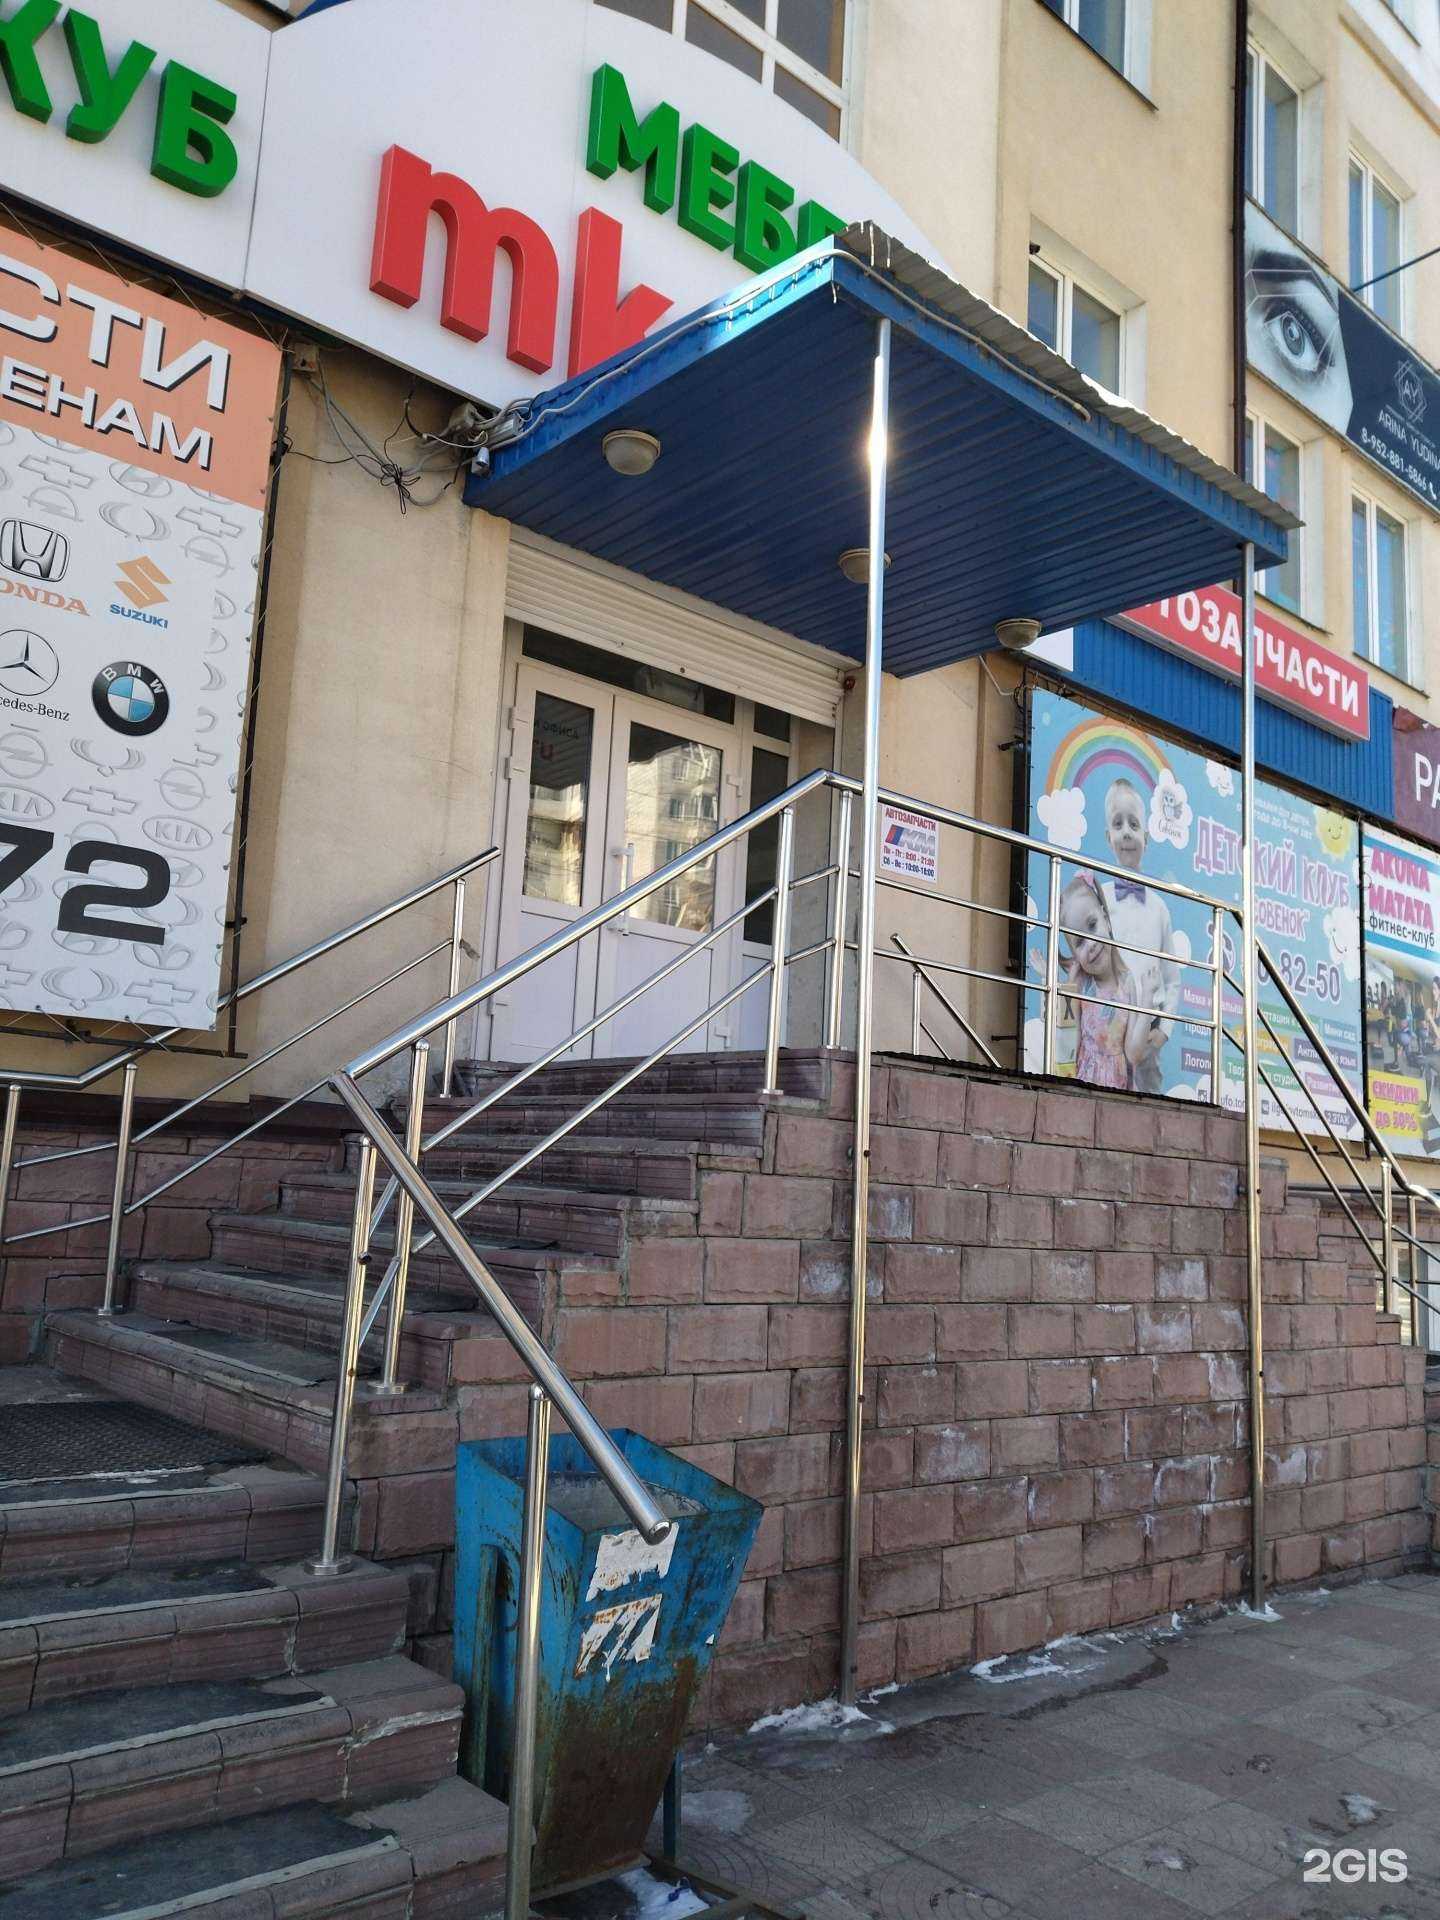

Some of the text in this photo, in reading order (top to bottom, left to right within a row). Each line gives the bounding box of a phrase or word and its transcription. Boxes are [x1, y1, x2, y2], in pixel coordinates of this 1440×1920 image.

[0, 356, 213, 472] ЕНАМ
[1379, 408, 1408, 444] ARINA
[109, 603, 169, 629] SUZUKI
[101, 663, 165, 694] BMW
[153, 819, 205, 847] KIA
[1303, 856, 1349, 907] КЛУБ
[1369, 911, 1435, 950] фитнес-клуб
